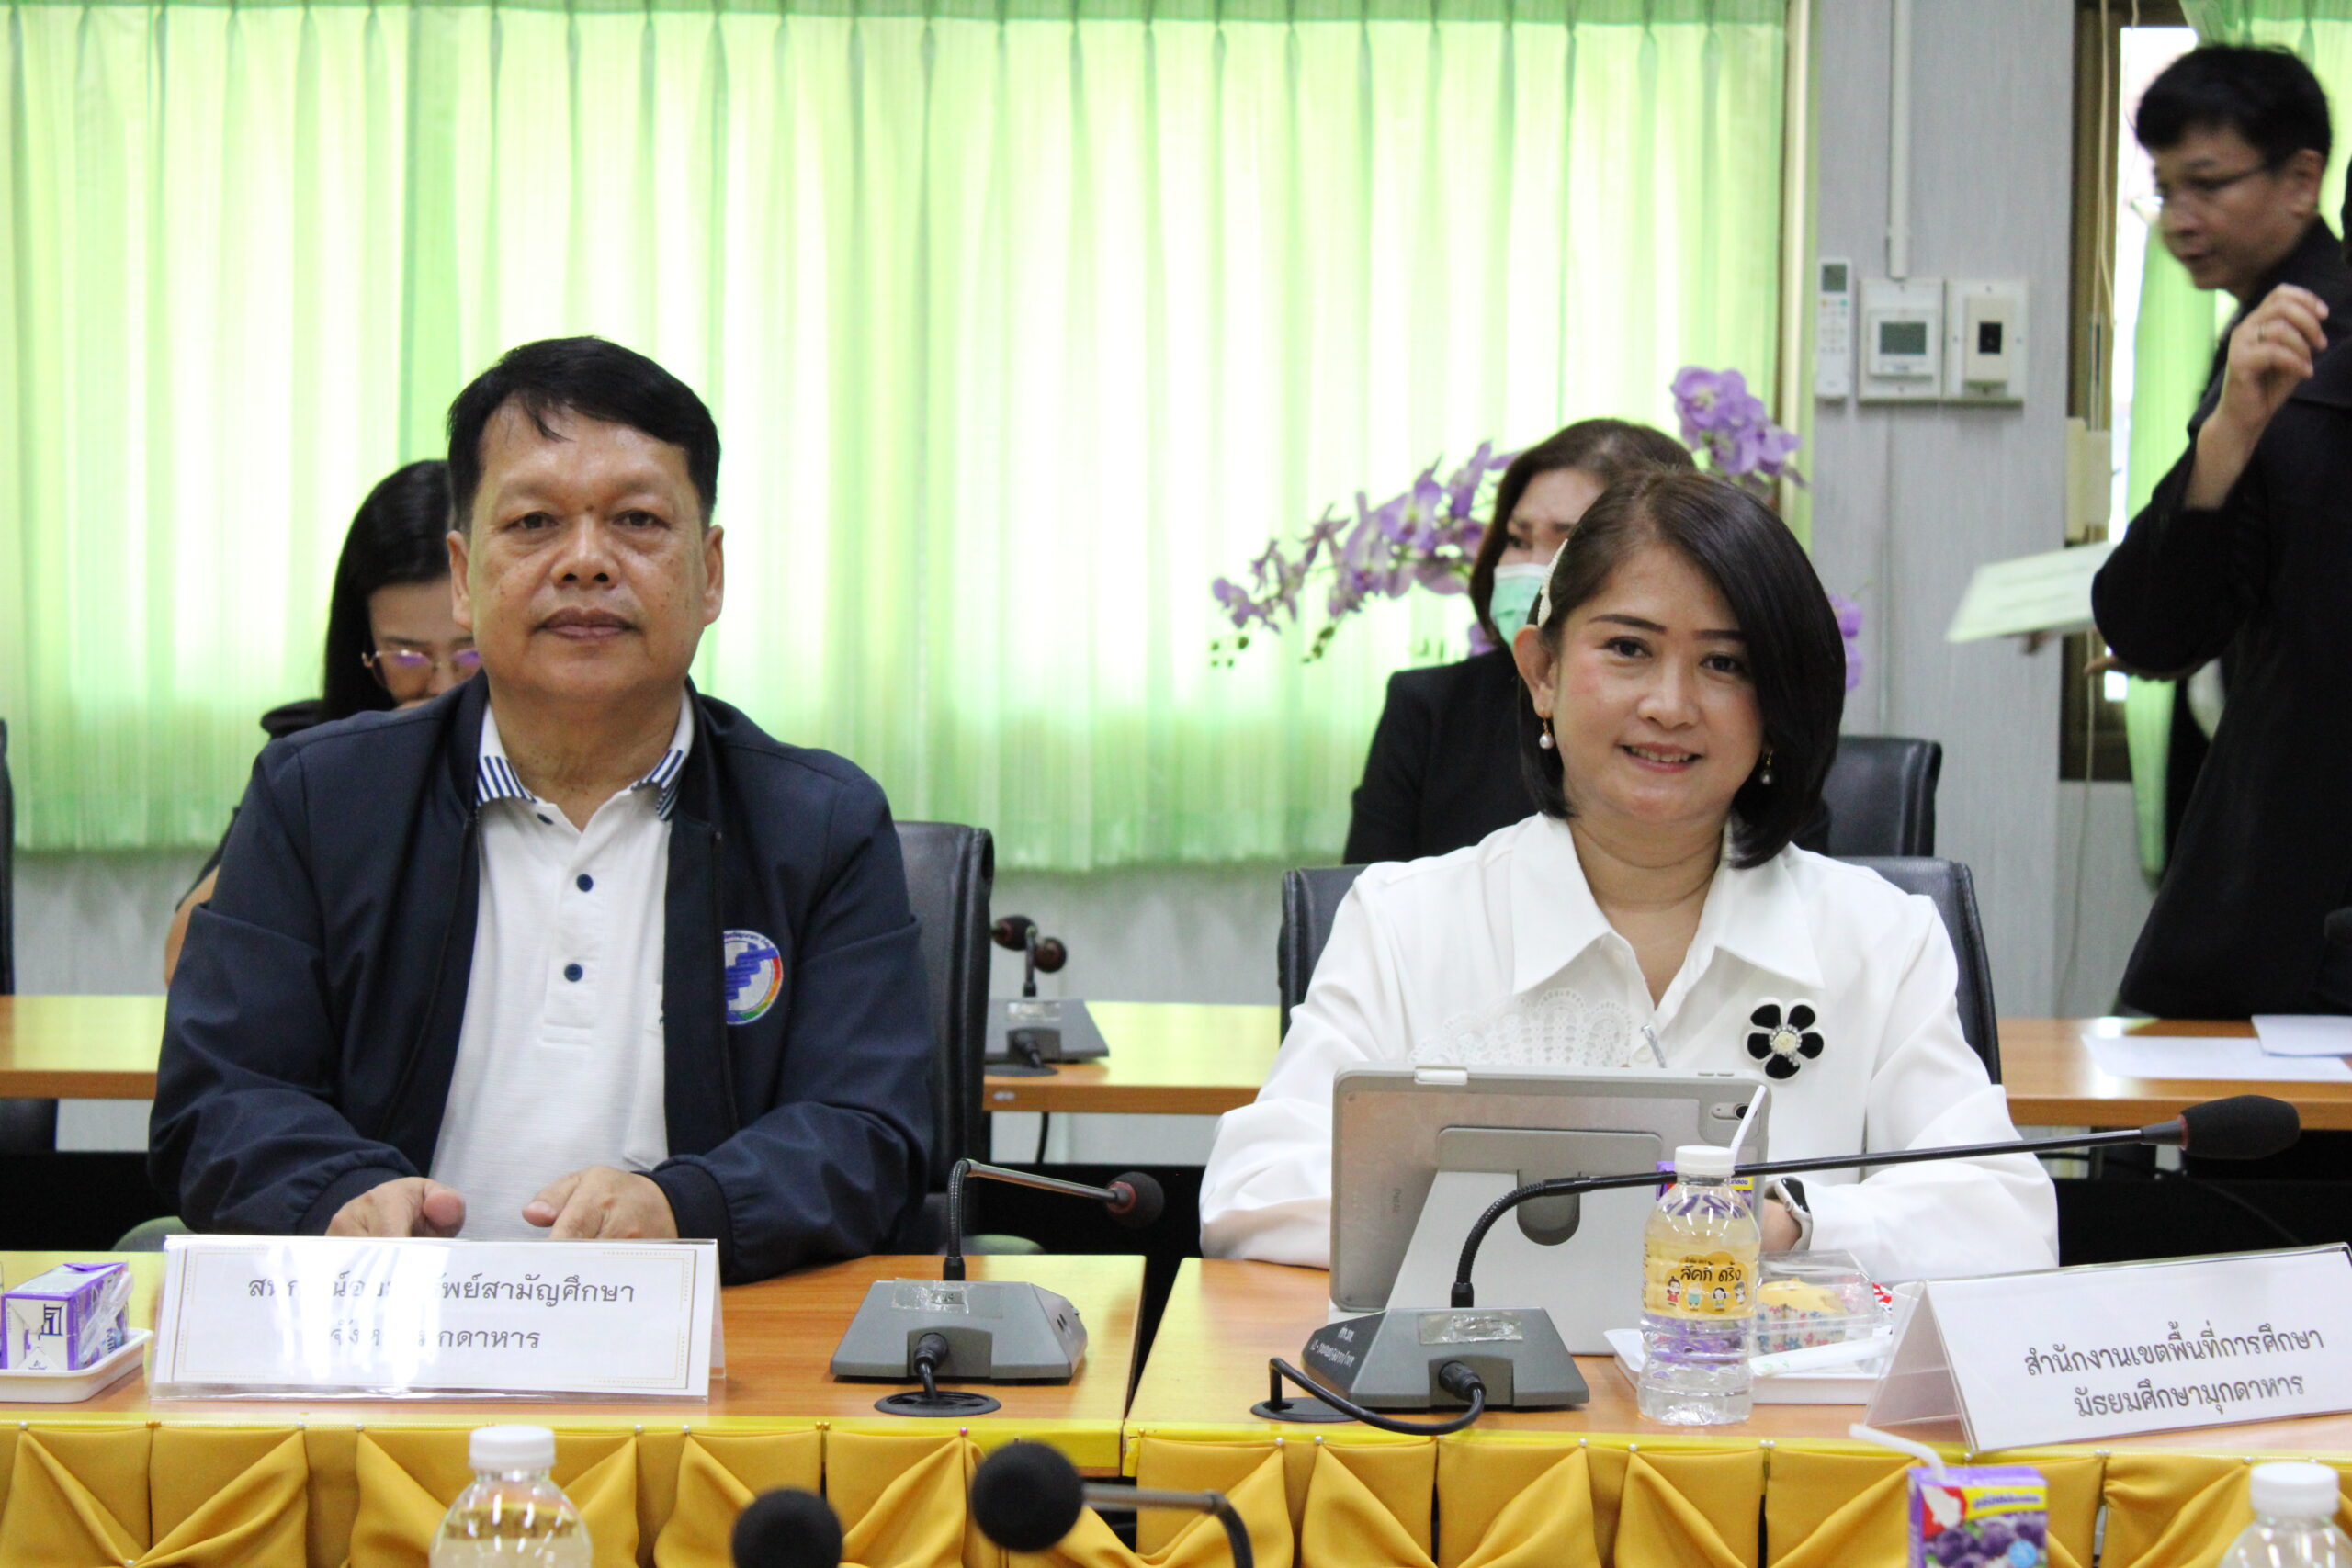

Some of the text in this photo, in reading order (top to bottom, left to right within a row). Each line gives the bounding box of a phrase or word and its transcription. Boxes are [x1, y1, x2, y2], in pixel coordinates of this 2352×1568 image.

[2024, 1320, 2324, 1376] สำนักงานเขตพื้นที่การศึกษา
[2074, 1375, 2305, 1416] มัธยมศึกษามุกดาหาร
